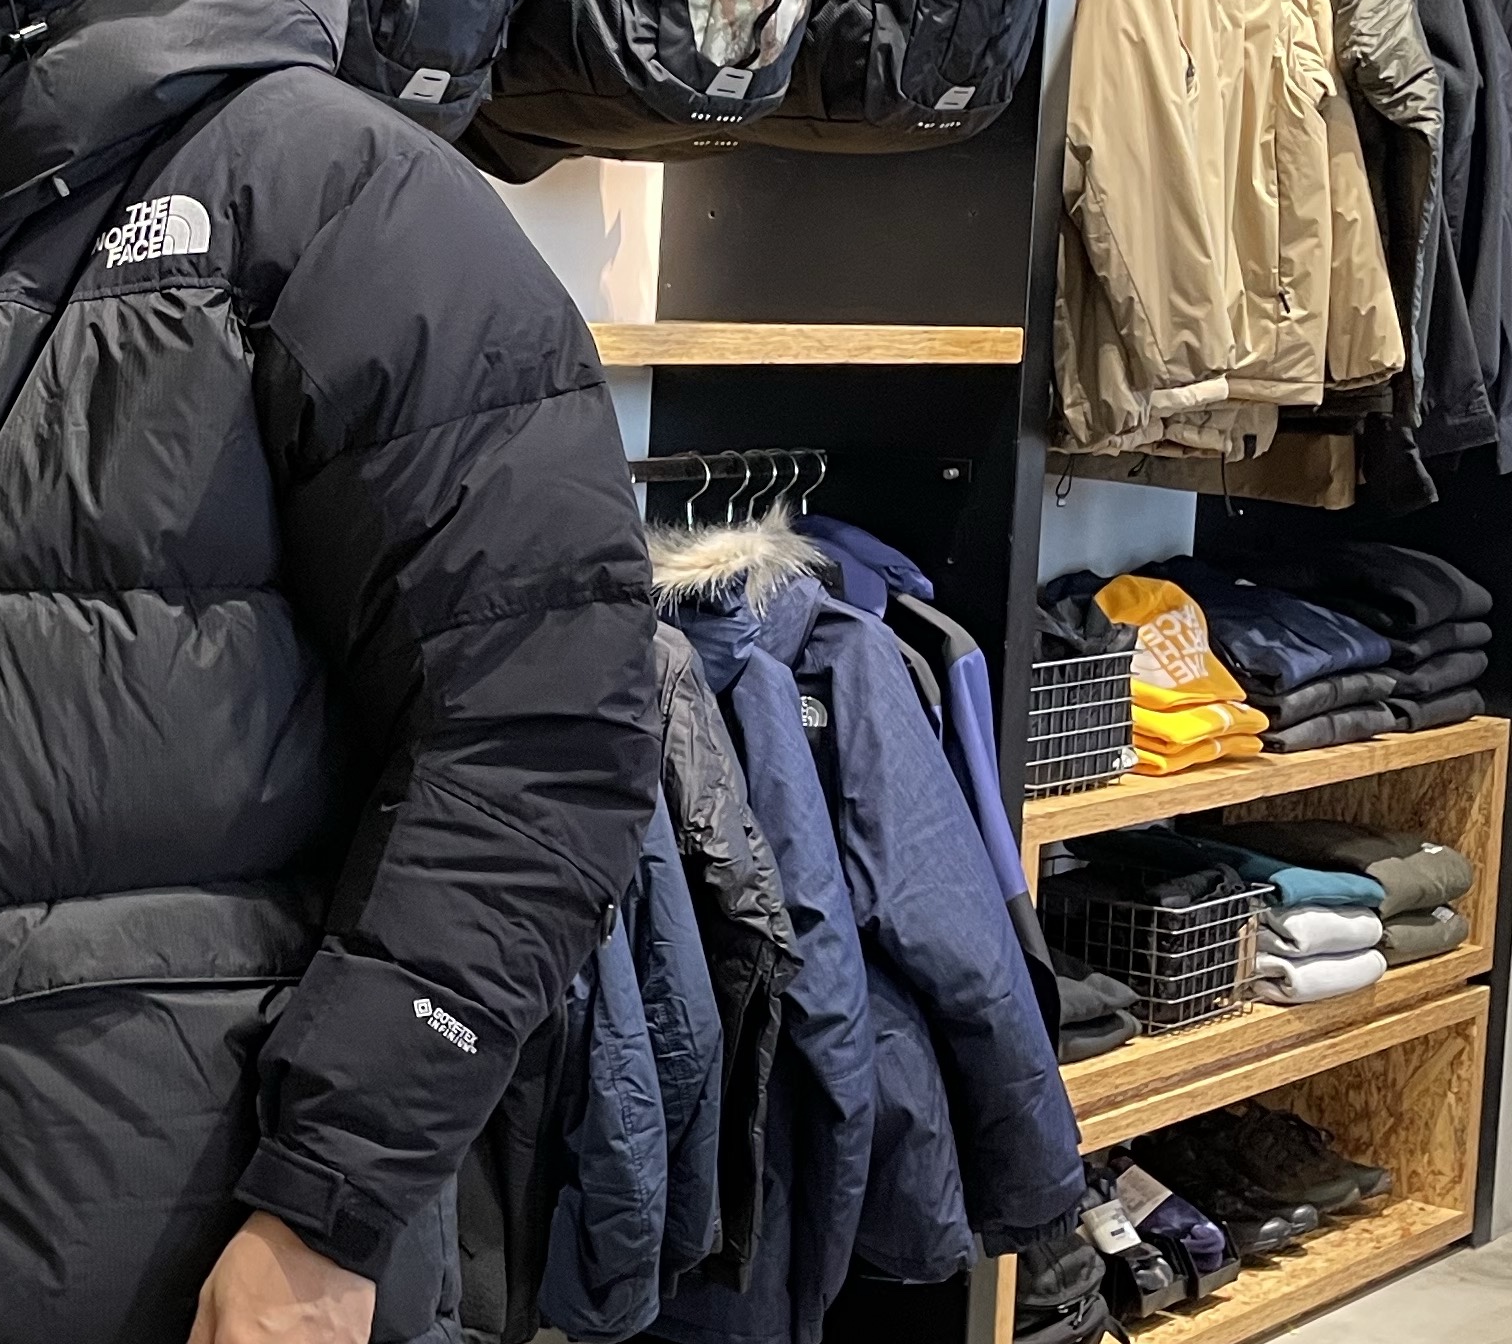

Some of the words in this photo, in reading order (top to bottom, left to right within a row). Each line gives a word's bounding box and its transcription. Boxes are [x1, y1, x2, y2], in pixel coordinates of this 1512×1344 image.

[126, 196, 171, 224] THE
[90, 218, 168, 256] NORTH
[106, 237, 163, 269] FACE
